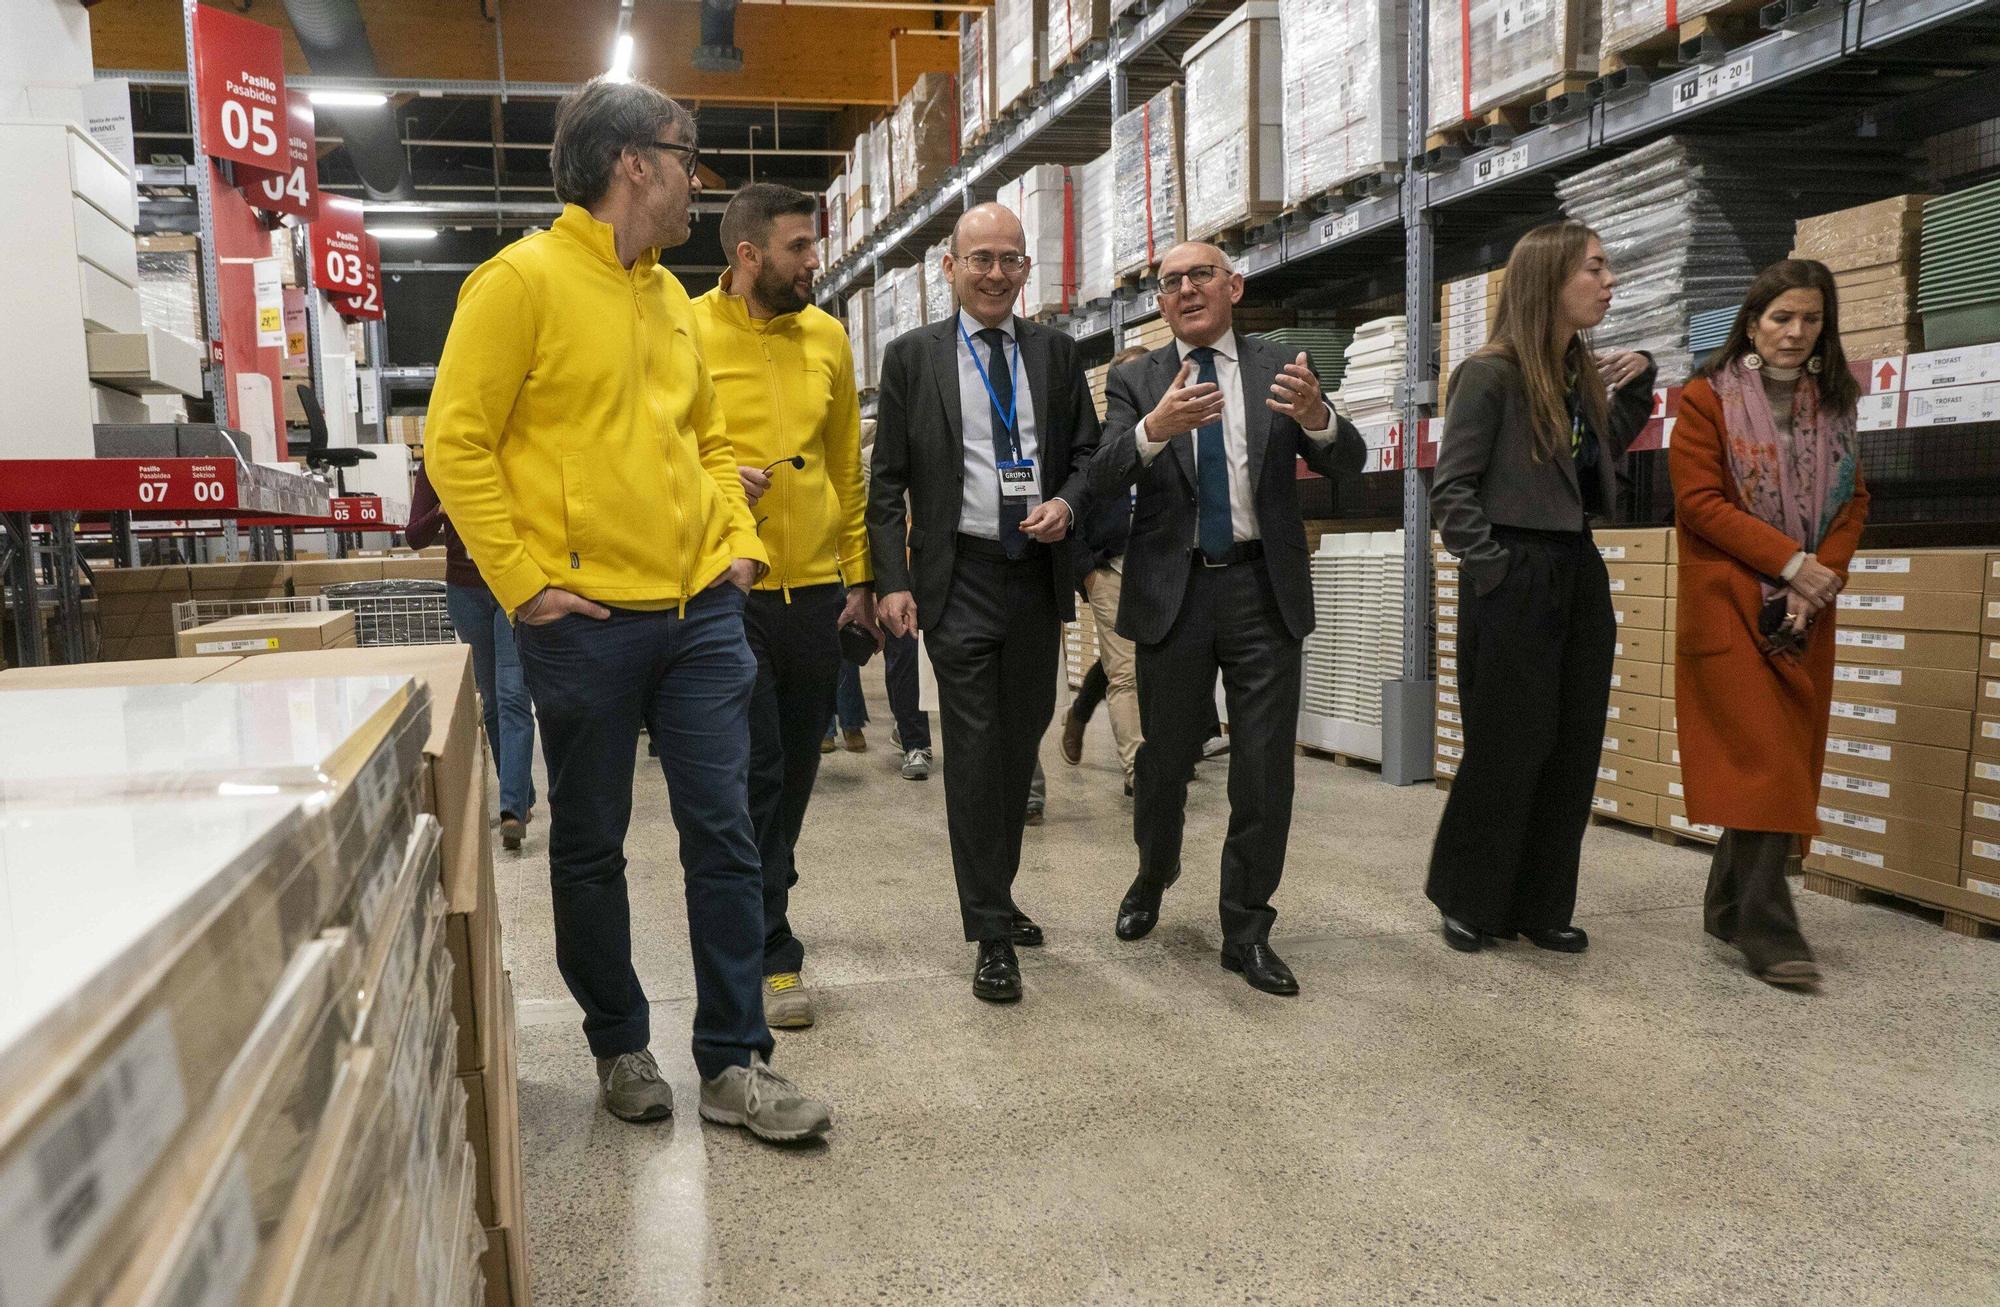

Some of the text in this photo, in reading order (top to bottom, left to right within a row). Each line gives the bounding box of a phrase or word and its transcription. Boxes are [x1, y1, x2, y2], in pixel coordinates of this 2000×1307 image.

[242, 71, 276, 92] Pasillo
[1682, 65, 1742, 98] 11 14 20
[226, 80, 277, 105] Pasabidea
[221, 100, 278, 156] 05
[326, 237, 359, 251] Pasabidea
[336, 231, 358, 242] Pasillo
[326, 251, 362, 286] 03
[214, 347, 223, 360] 05
[1935, 356, 1961, 365] TROFAST
[1935, 396, 1962, 405] TROFAST
[139, 481, 224, 503] 07 00
[334, 508, 377, 520] 05 00
